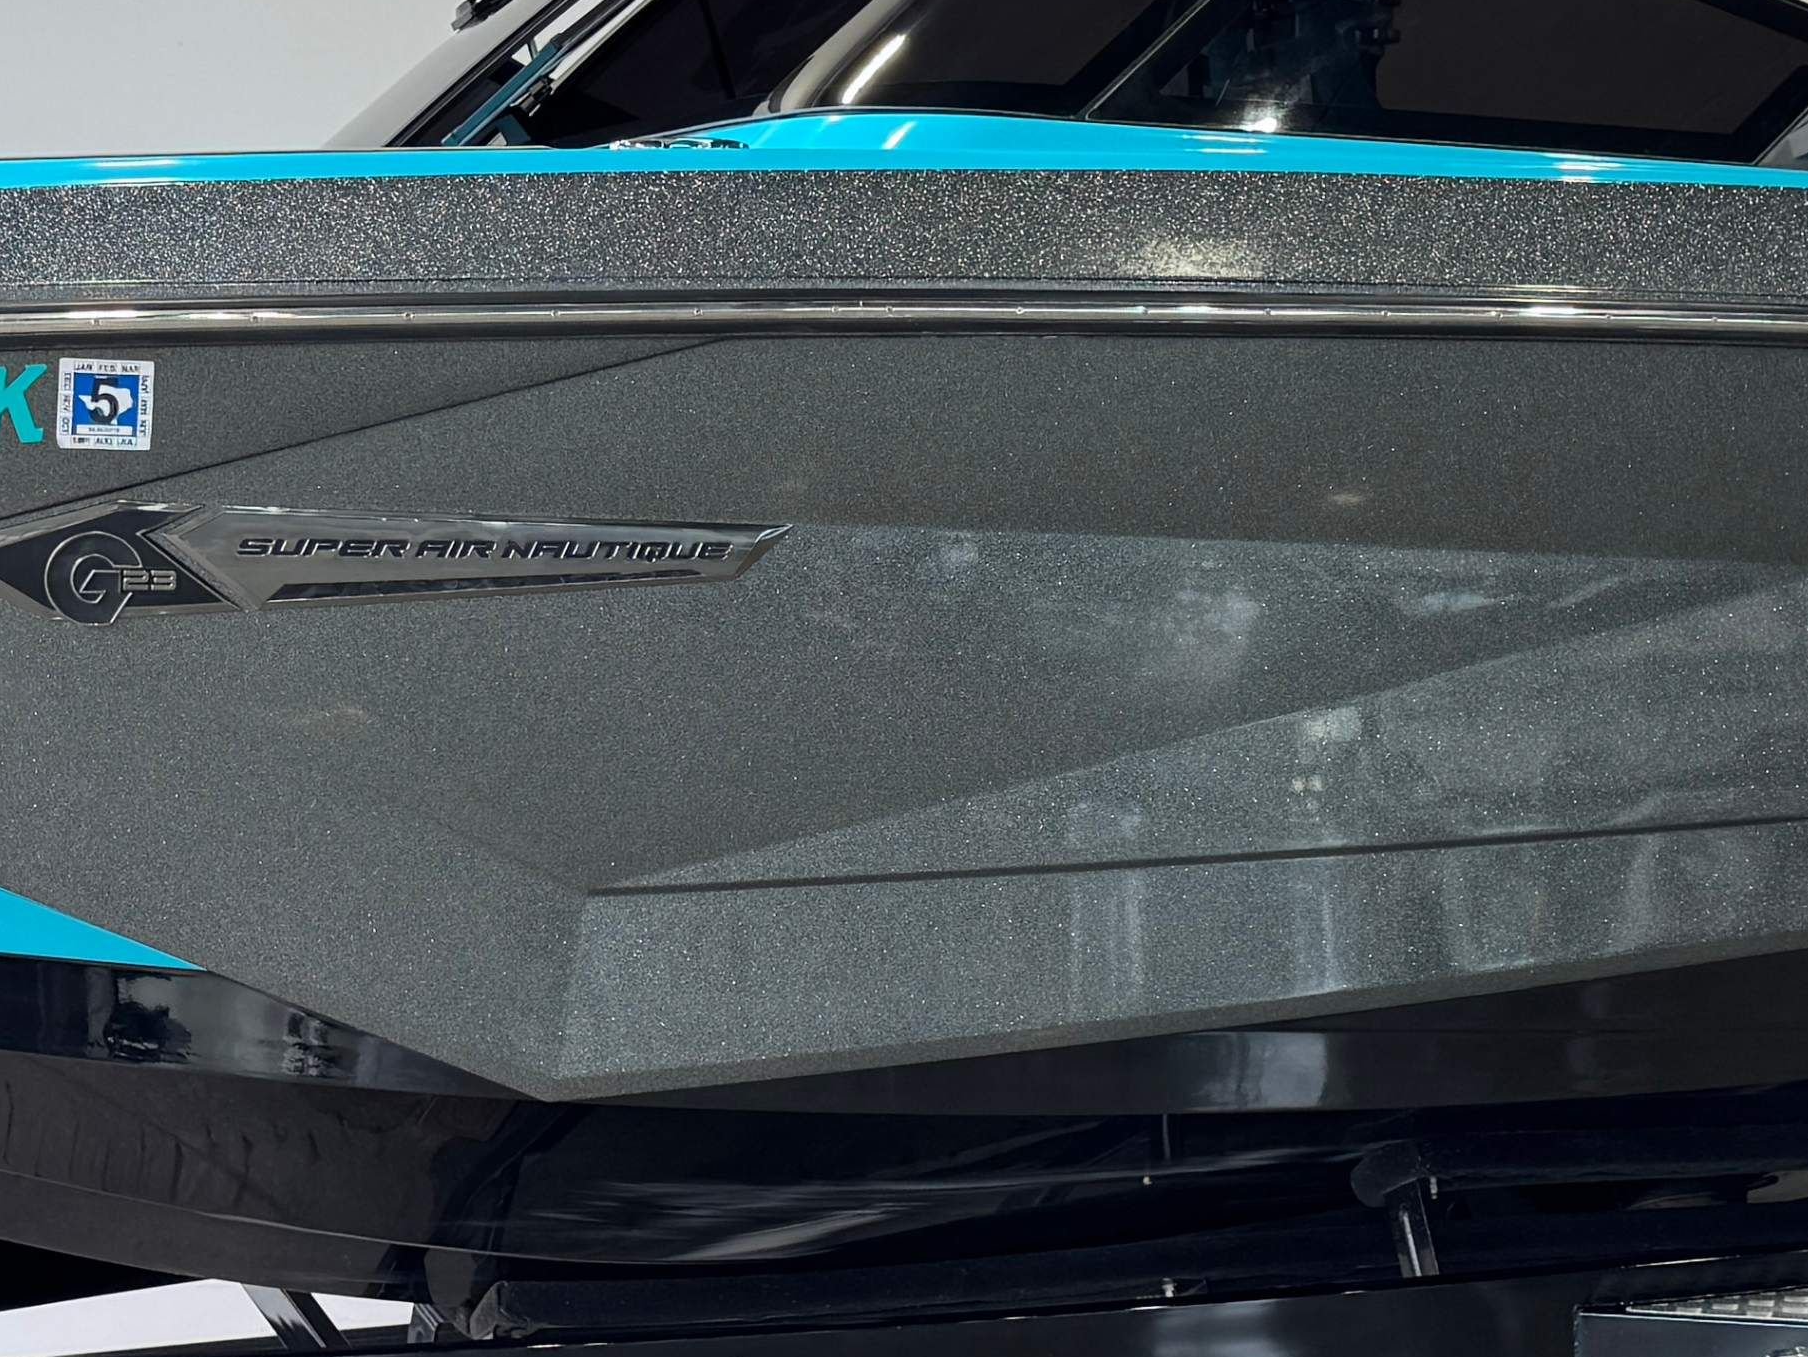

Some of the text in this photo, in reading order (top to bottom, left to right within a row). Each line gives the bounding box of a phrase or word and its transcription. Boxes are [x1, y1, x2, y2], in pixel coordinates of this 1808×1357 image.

[90, 376, 120, 425] 5
[236, 537, 734, 564] SUPER AIR NAUTIQUE
